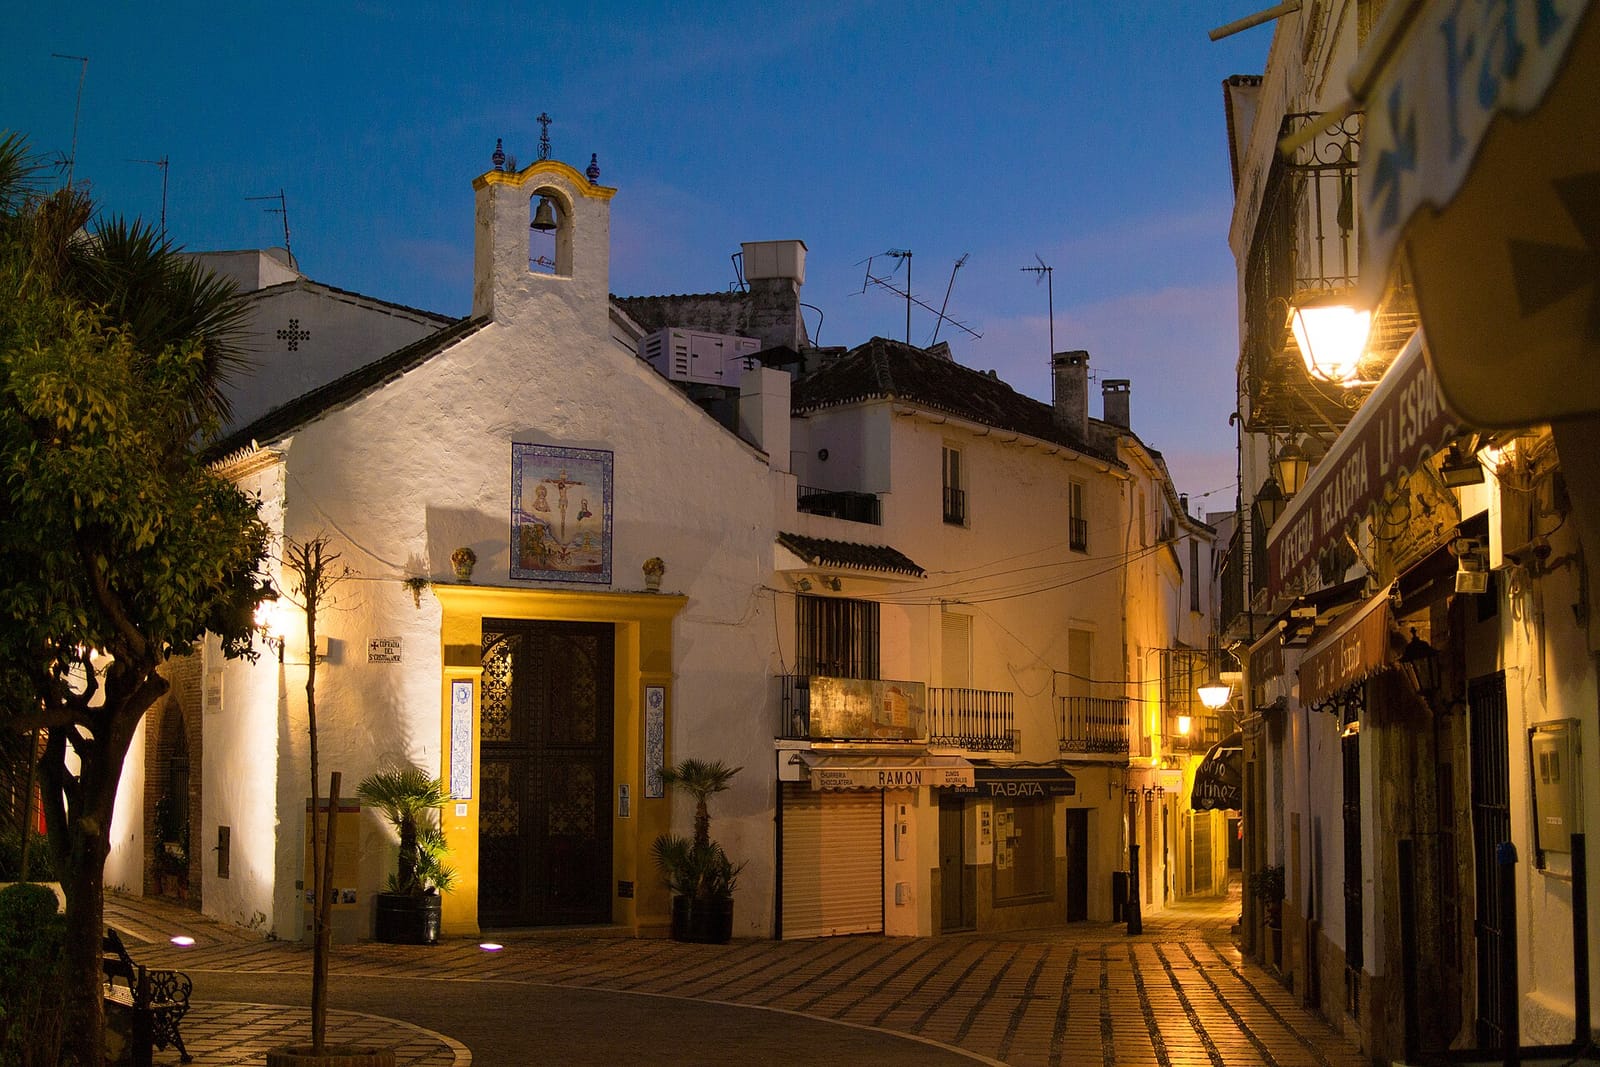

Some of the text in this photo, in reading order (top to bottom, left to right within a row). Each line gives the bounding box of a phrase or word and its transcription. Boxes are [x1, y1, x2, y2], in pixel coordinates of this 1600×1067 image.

[1380, 409, 1394, 477] LA
[878, 771, 922, 785] RAMON
[986, 782, 1045, 796] TABATA
